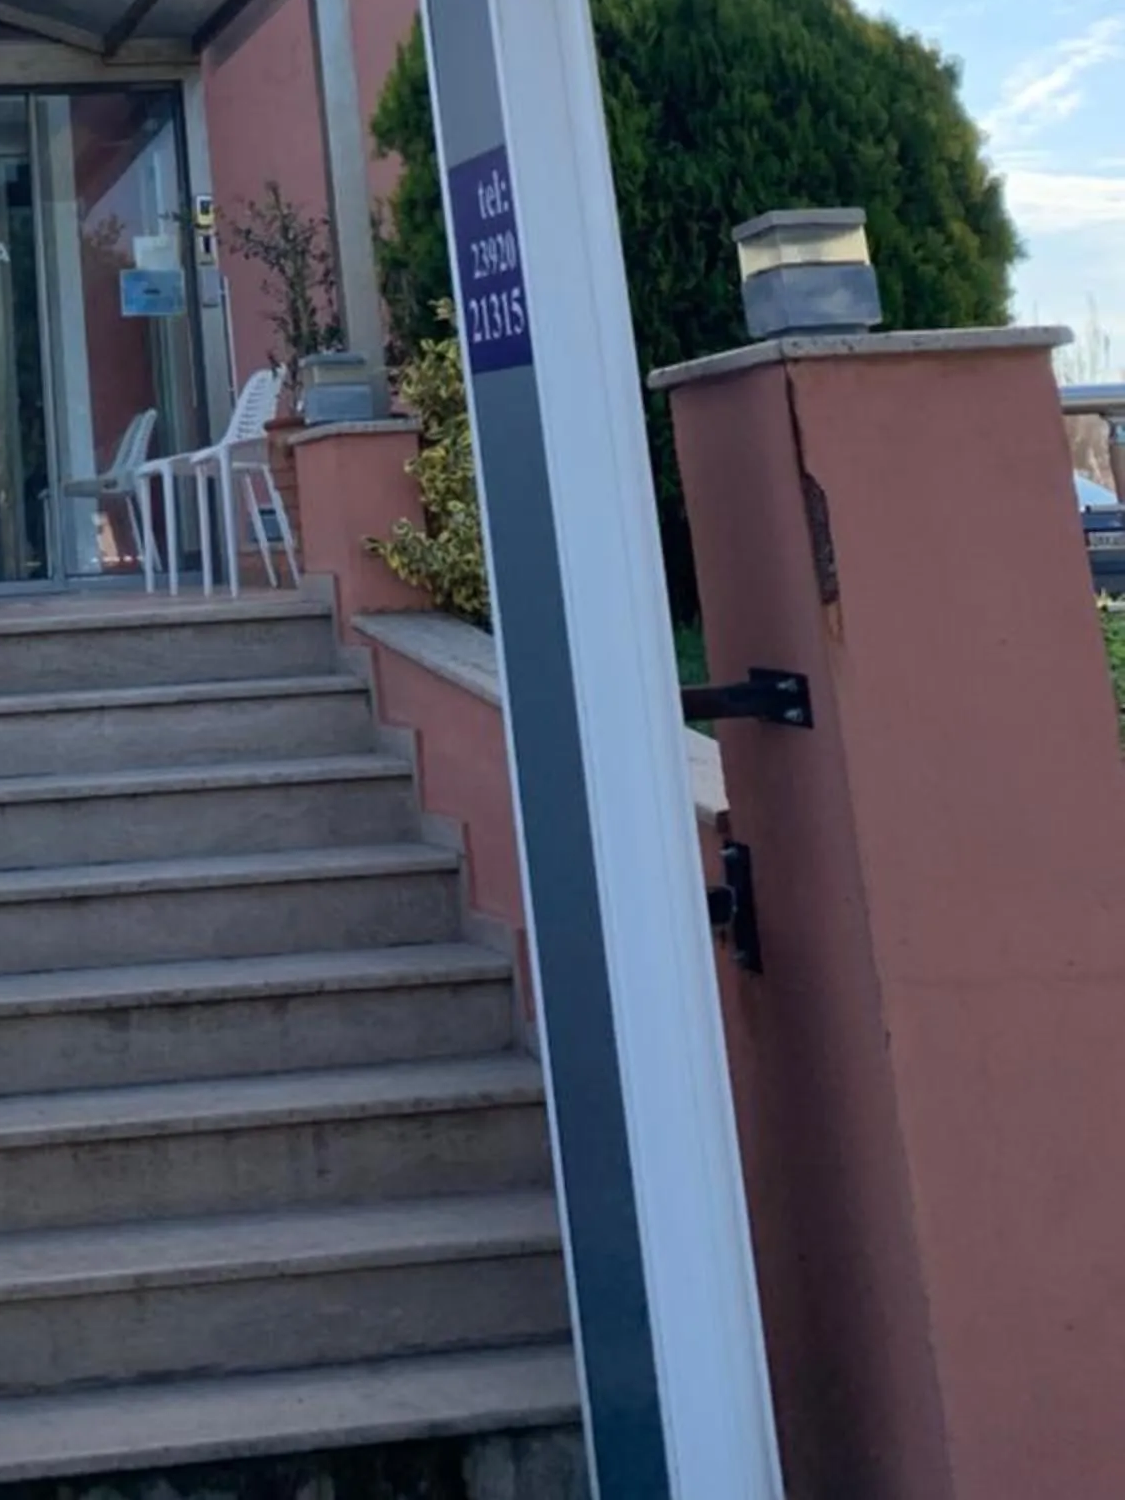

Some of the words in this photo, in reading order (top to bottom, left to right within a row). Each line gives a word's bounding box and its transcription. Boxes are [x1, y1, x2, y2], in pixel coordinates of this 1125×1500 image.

[477, 169, 510, 220] tel:
[471, 229, 518, 280] 23920
[469, 287, 526, 343] 21315
